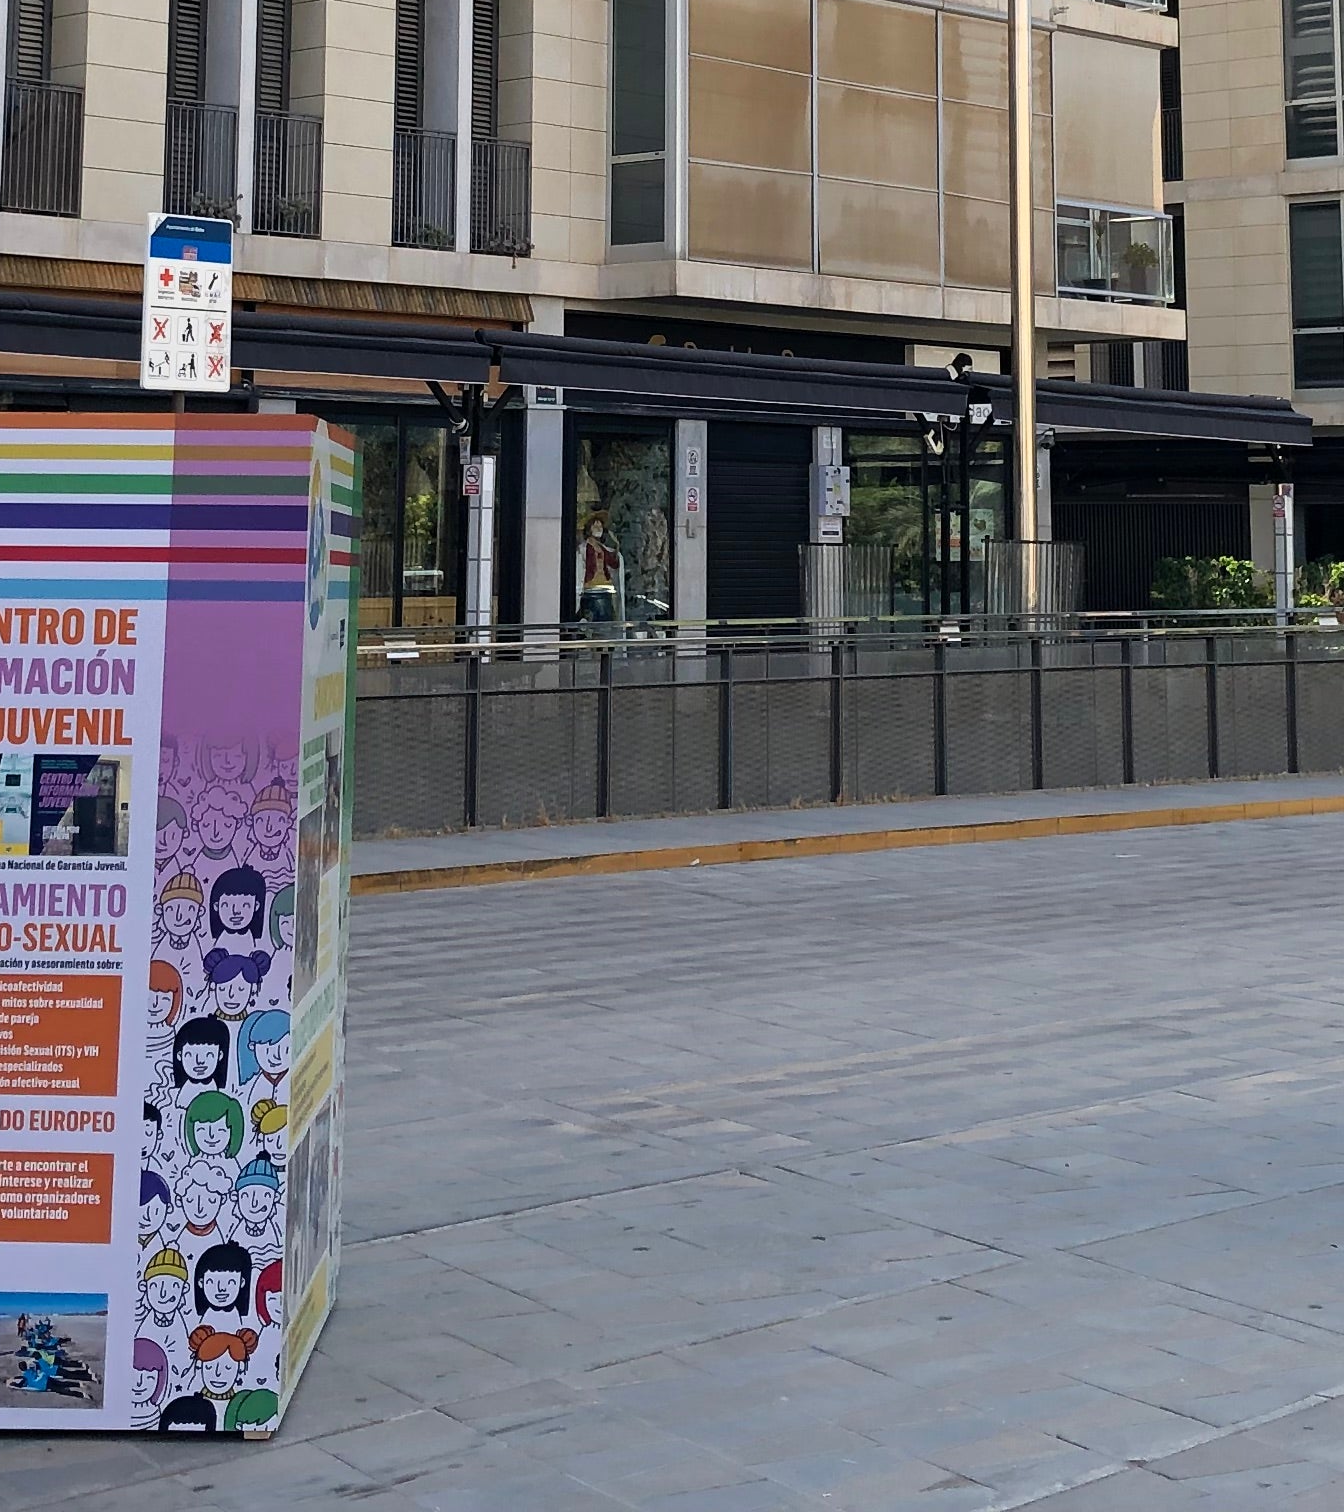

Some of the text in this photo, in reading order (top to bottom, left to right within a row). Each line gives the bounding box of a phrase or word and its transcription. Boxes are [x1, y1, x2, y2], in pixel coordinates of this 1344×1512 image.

[93, 608, 138, 646] DE
[8, 860, 44, 870] Nacional
[45, 861, 55, 870] de
[57, 860, 92, 870] Garantía
[95, 861, 127, 871] Juvenil.
[25, 961, 30, 969] y
[32, 960, 94, 969] asesoramiento
[96, 960, 123, 970] sobre:
[23, 1045, 53, 1056] Sexual
[55, 1045, 75, 1058] (ITS)
[84, 1046, 99, 1057] VIH
[29, 1110, 115, 1133] EUROPEO
[16, 1161, 22, 1171] a
[24, 1159, 76, 1173] encontrar
[78, 1160, 88, 1173] el
[44, 1178, 50, 1190] y
[52, 1176, 93, 1188] realizar
[24, 1191, 100, 1205] organizadores
[1, 1206, 69, 1220] voluntariado
